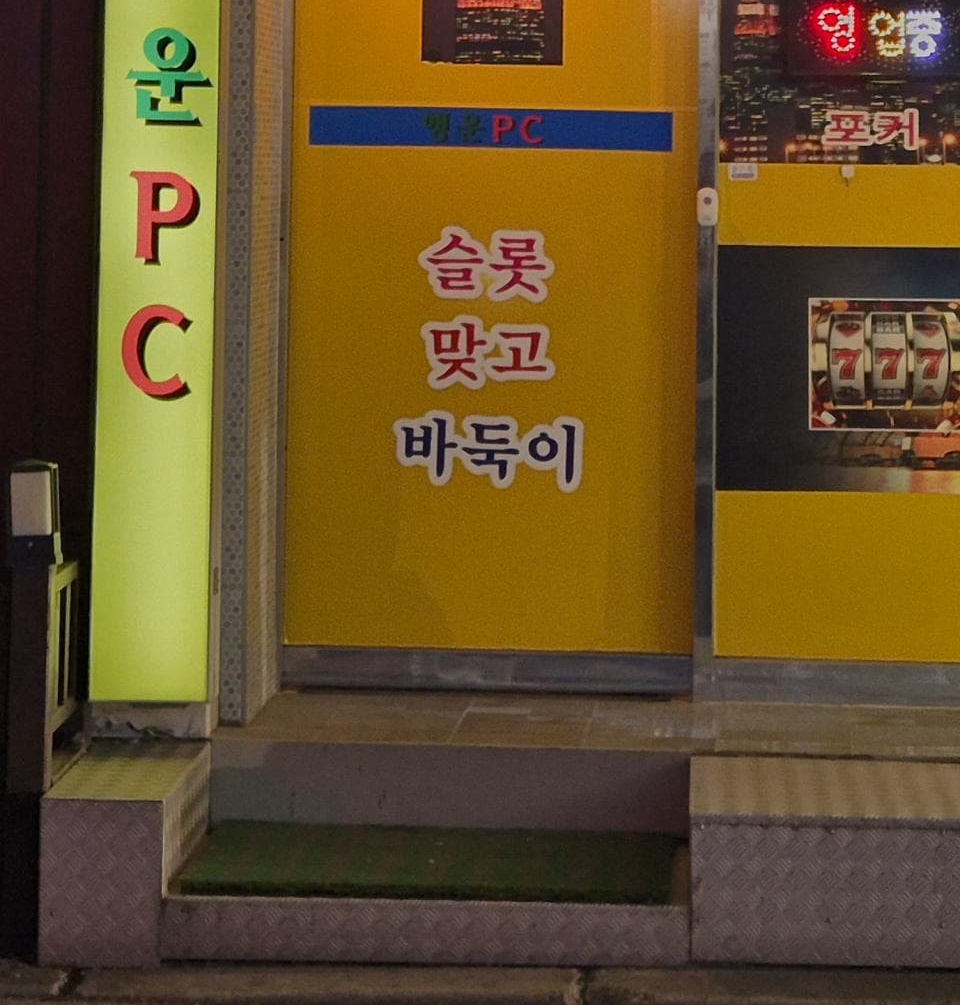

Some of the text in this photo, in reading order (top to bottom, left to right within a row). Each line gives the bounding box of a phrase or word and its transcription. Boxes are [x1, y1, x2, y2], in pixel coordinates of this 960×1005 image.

[816, 4, 943, 58] 영업중
[425, 112, 544, 145] 행운 PC
[824, 109, 917, 149] 포커
[121, 169, 199, 400] PC
[425, 232, 548, 295] 슬롯
[428, 321, 549, 383] 맞고
[400, 416, 578, 485] 바둑이
